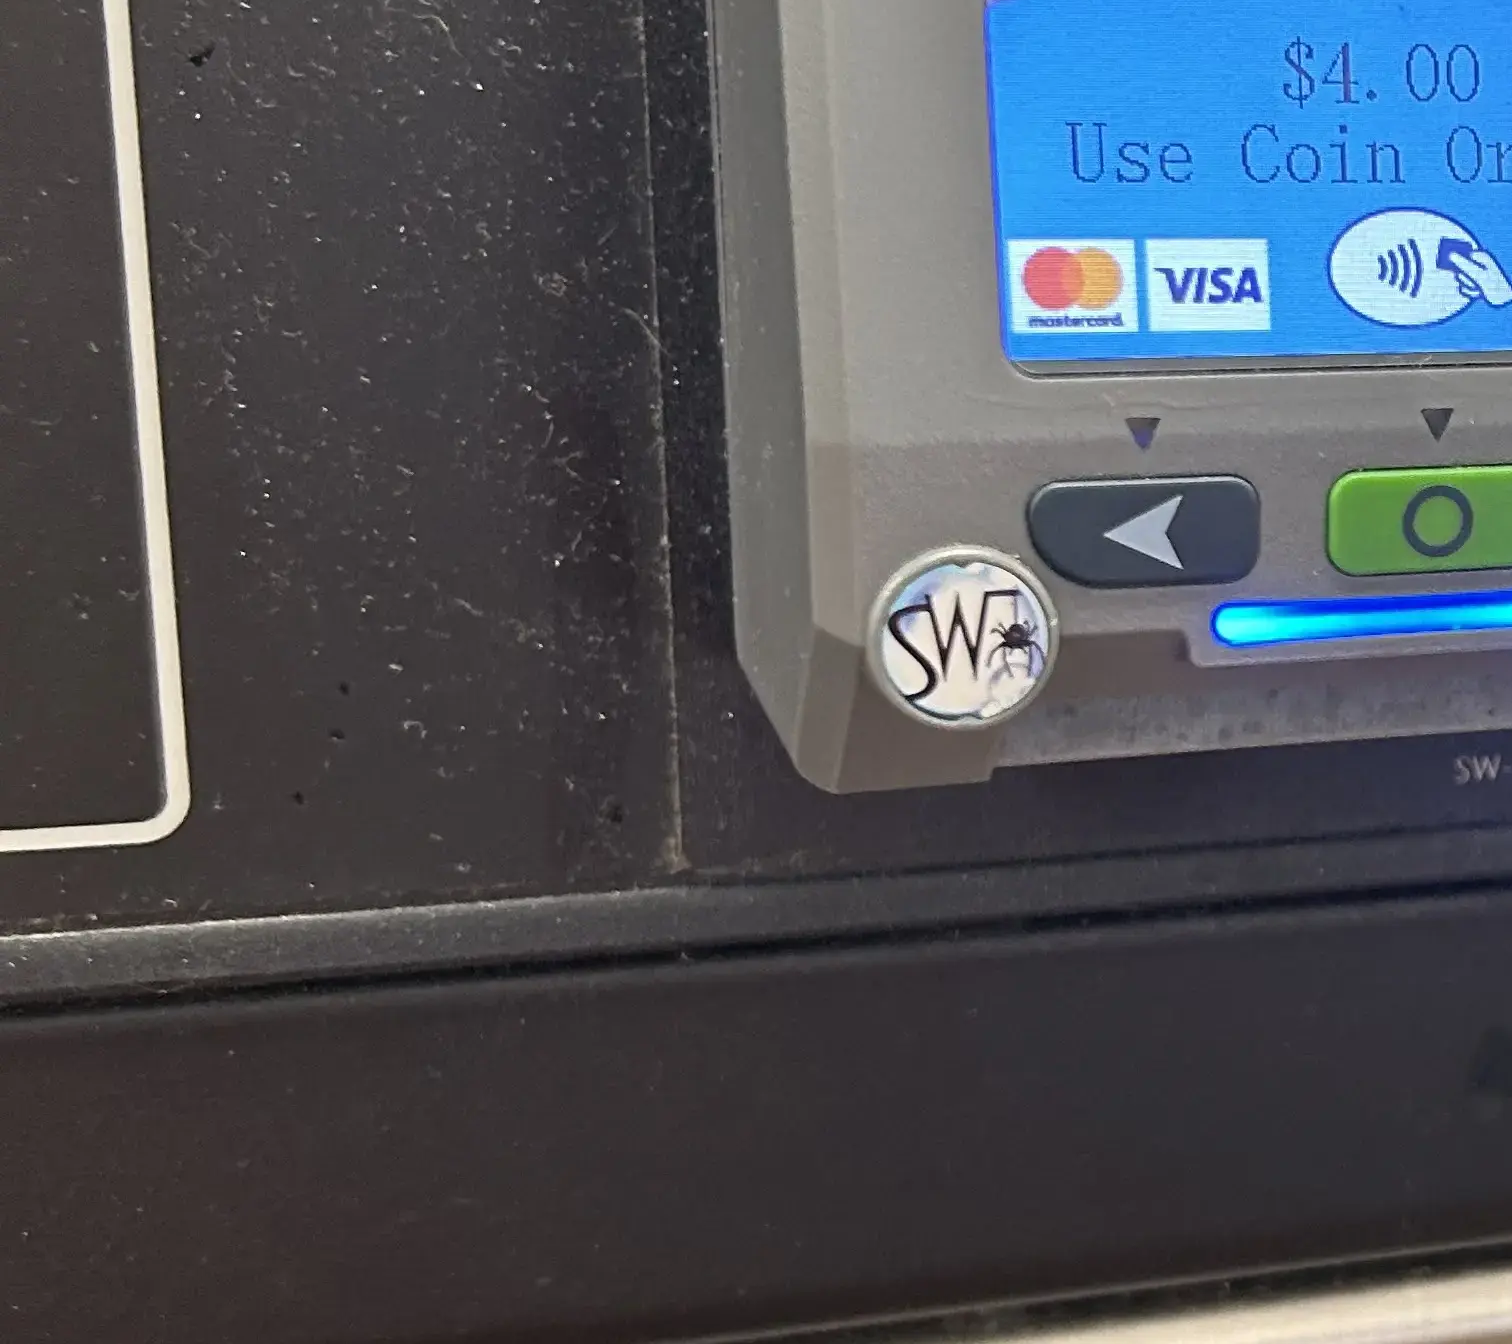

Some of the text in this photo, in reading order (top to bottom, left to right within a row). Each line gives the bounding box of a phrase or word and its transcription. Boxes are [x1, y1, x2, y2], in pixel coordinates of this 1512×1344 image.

[1283, 37, 1481, 109] $4.00
[1064, 121, 1194, 185] Use
[1242, 122, 1402, 186] Coin
[1154, 267, 1263, 304] VISA
